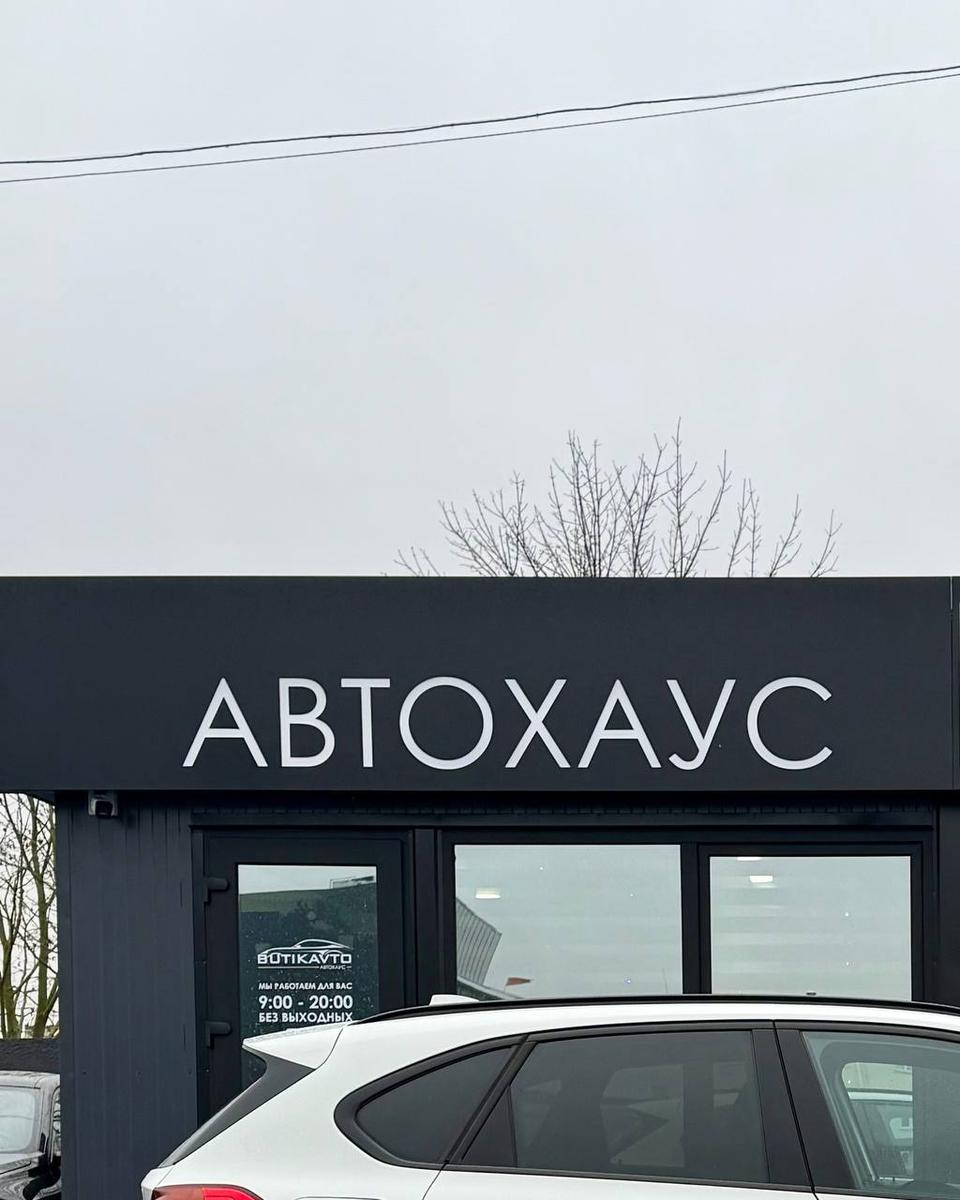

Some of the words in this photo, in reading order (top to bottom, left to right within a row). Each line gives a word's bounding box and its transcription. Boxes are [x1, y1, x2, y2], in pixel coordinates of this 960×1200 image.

[182, 676, 834, 771] АВТОХАУС
[257, 953, 352, 964] BUTIKAVTO
[317, 982, 334, 990] ДЛЯ
[336, 982, 353, 990] ВАС
[258, 995, 293, 1009] 9:00
[309, 995, 353, 1009] 20:00
[258, 1012, 278, 1023] БЕЗ
[282, 1012, 353, 1023] ВЫХОДНЫХ
